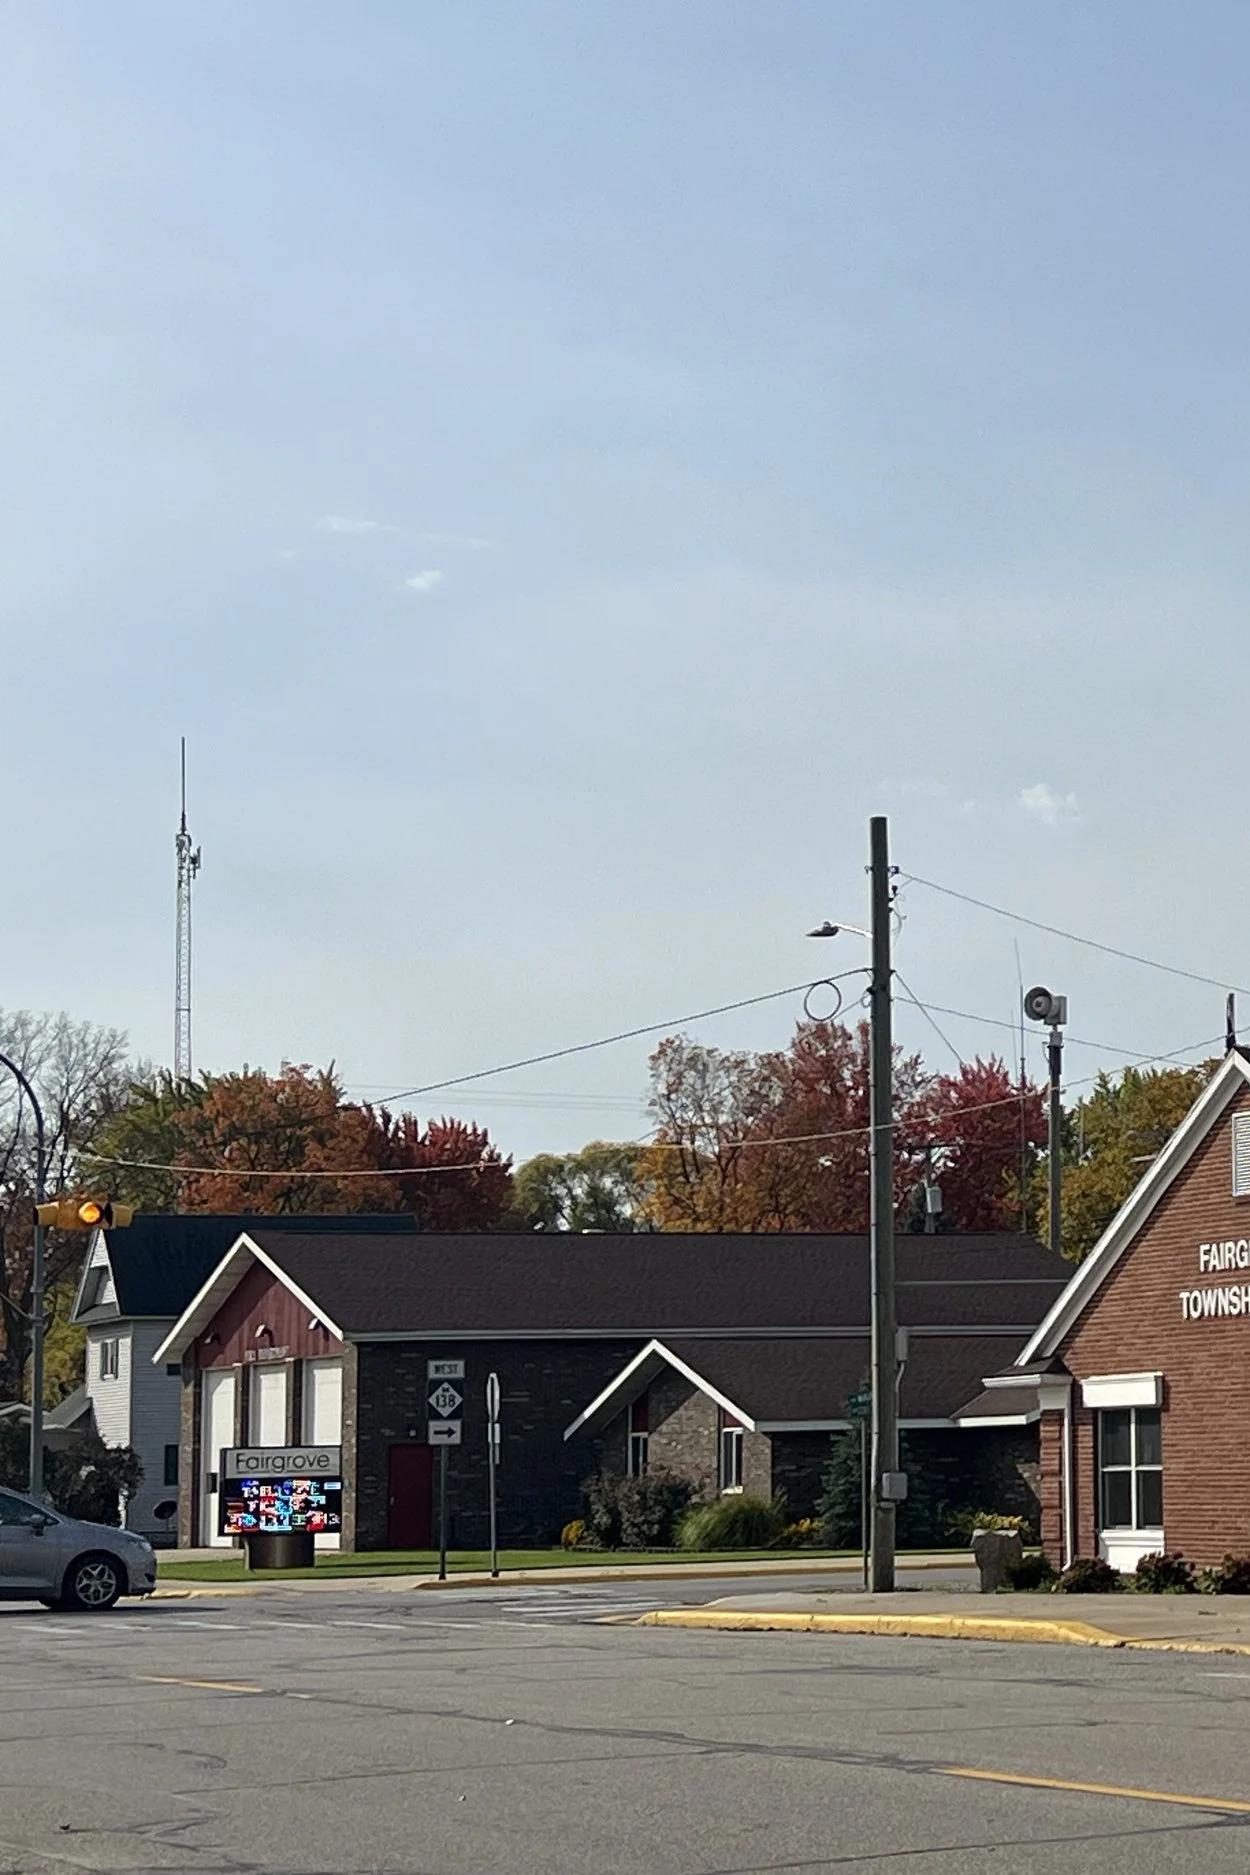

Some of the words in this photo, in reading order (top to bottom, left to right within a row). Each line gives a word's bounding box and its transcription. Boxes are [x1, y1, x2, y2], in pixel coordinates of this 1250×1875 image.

[434, 1364, 459, 1375] WEST
[435, 1394, 456, 1408] 138
[236, 1452, 330, 1473] Fairgrove
